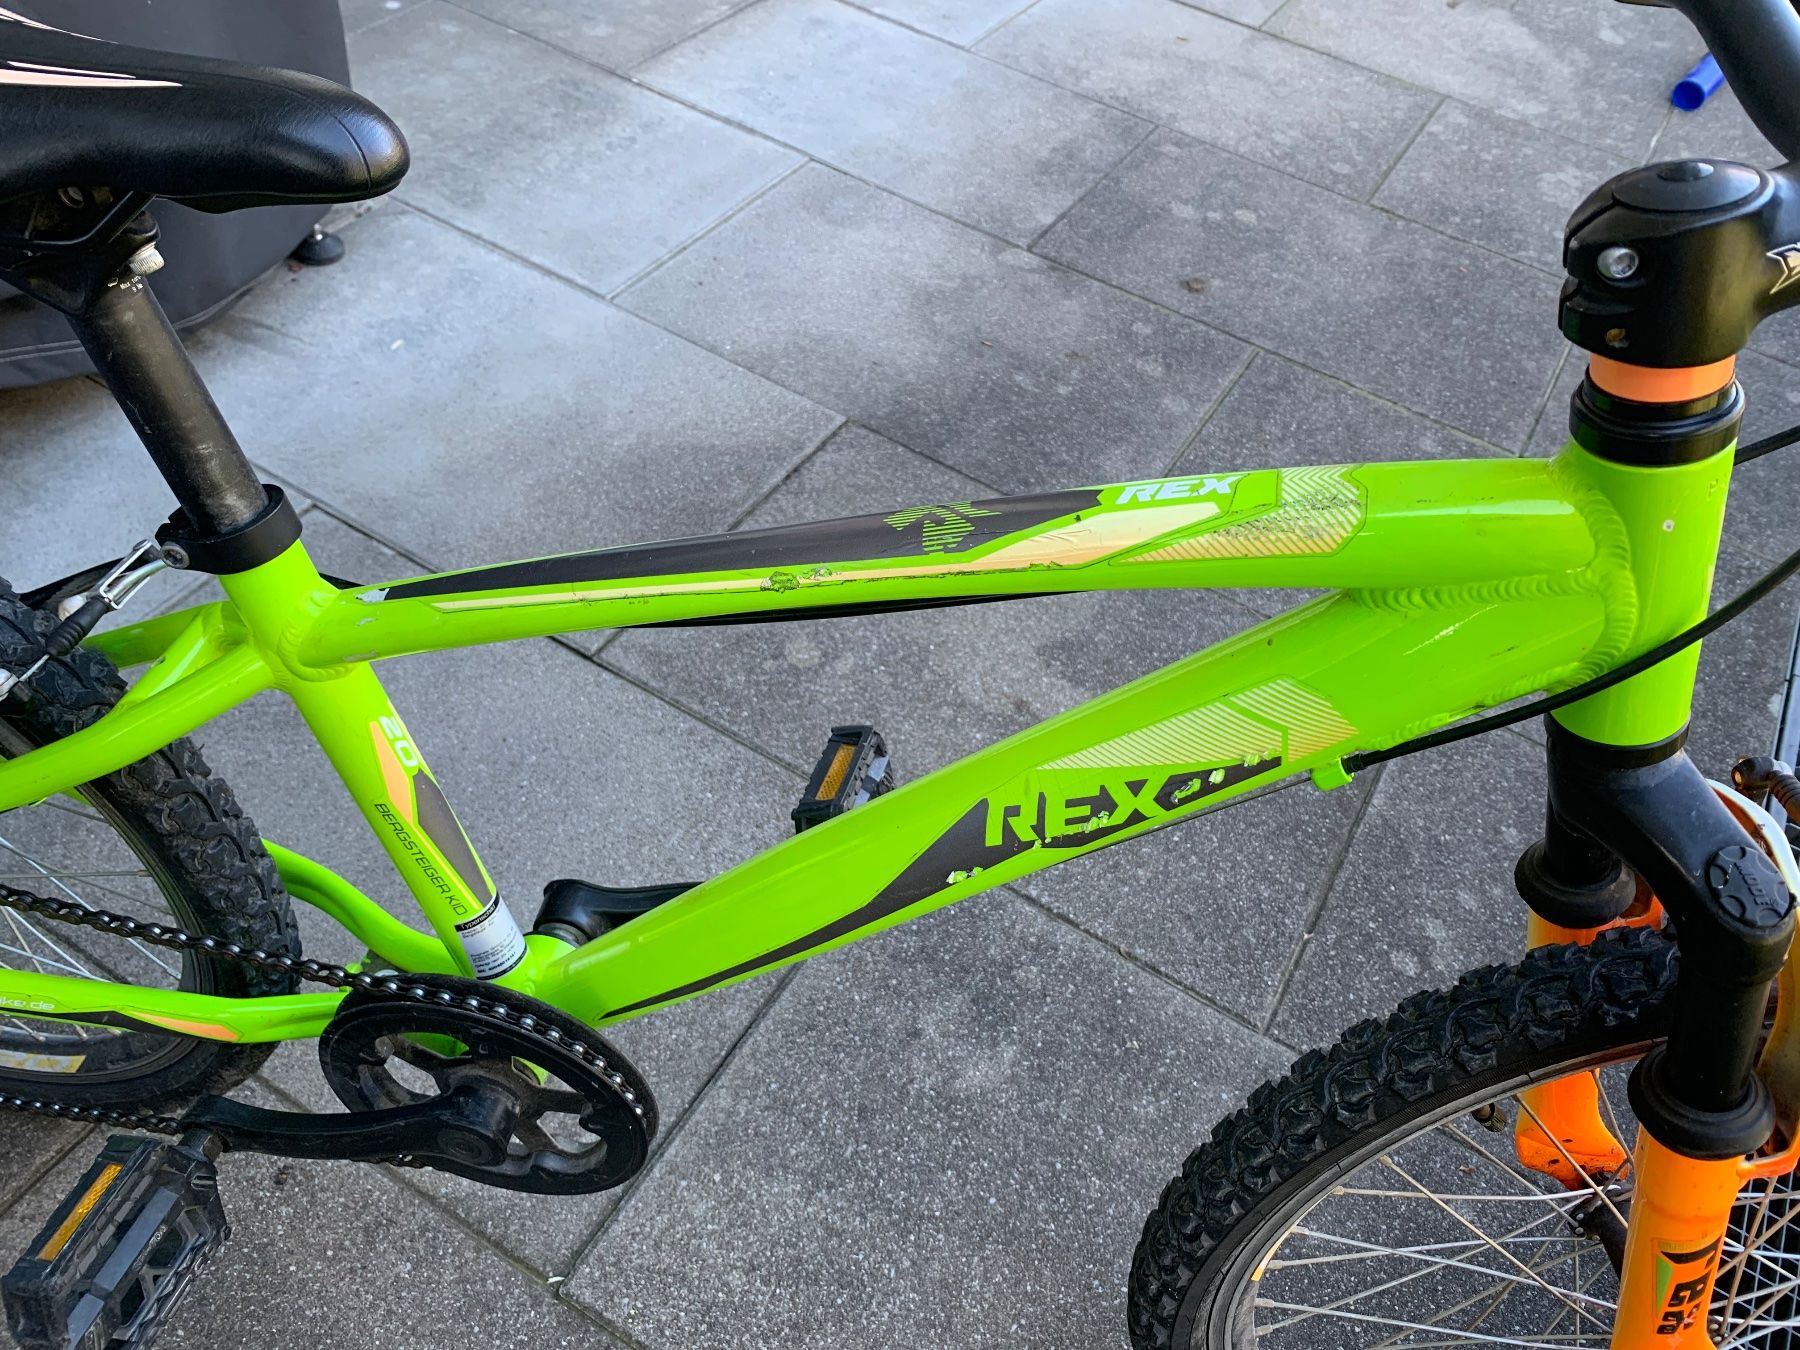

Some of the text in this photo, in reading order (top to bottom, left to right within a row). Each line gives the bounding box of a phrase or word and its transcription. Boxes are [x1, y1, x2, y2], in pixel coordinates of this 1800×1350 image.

[1115, 477, 1243, 505] REX
[378, 715, 420, 768] 20
[985, 776, 1171, 848] REX
[374, 803, 468, 916] BERGSTEIGER KID
